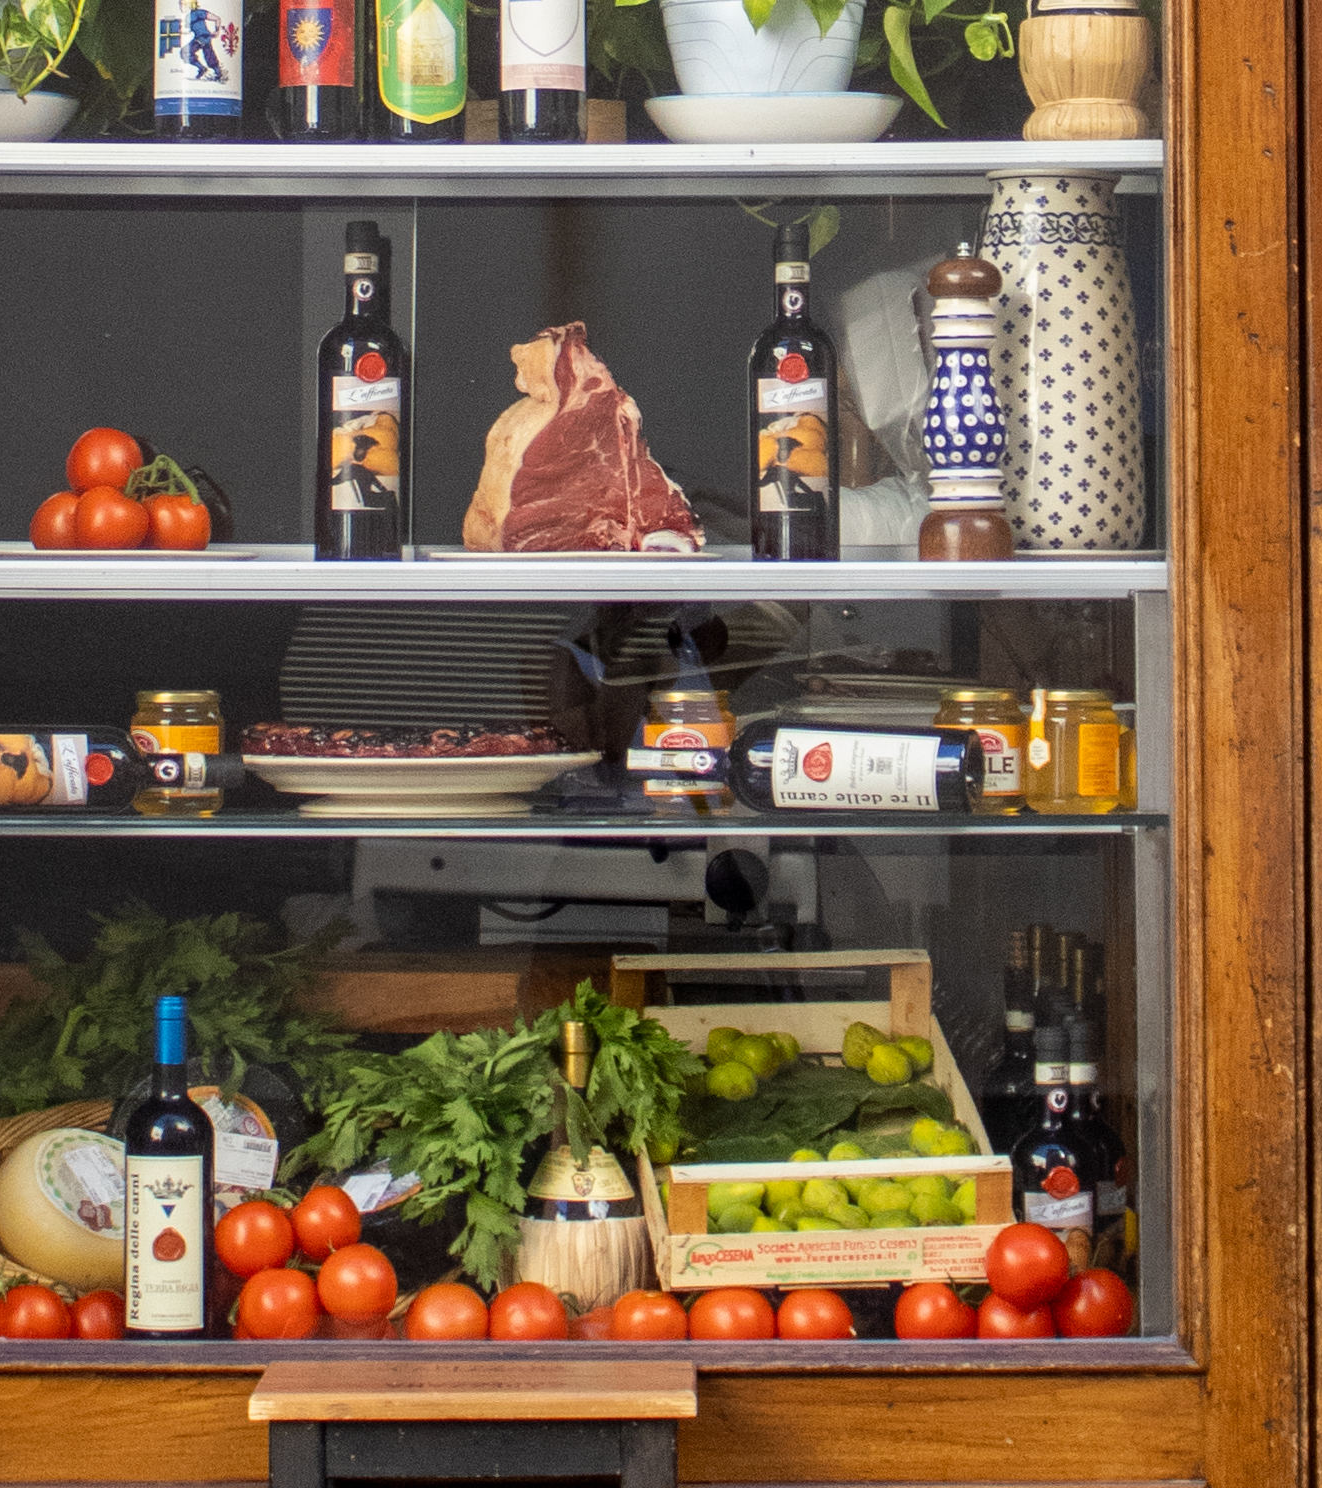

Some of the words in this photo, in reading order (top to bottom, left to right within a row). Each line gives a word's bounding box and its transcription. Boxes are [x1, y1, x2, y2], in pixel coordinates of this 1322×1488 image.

[779, 791, 828, 803] carni
[836, 792, 883, 805] delle
[891, 794, 909, 804] re
[130, 1173, 140, 1215] carni
[130, 1220, 140, 1259] delle
[130, 1264, 142, 1320] Regina
